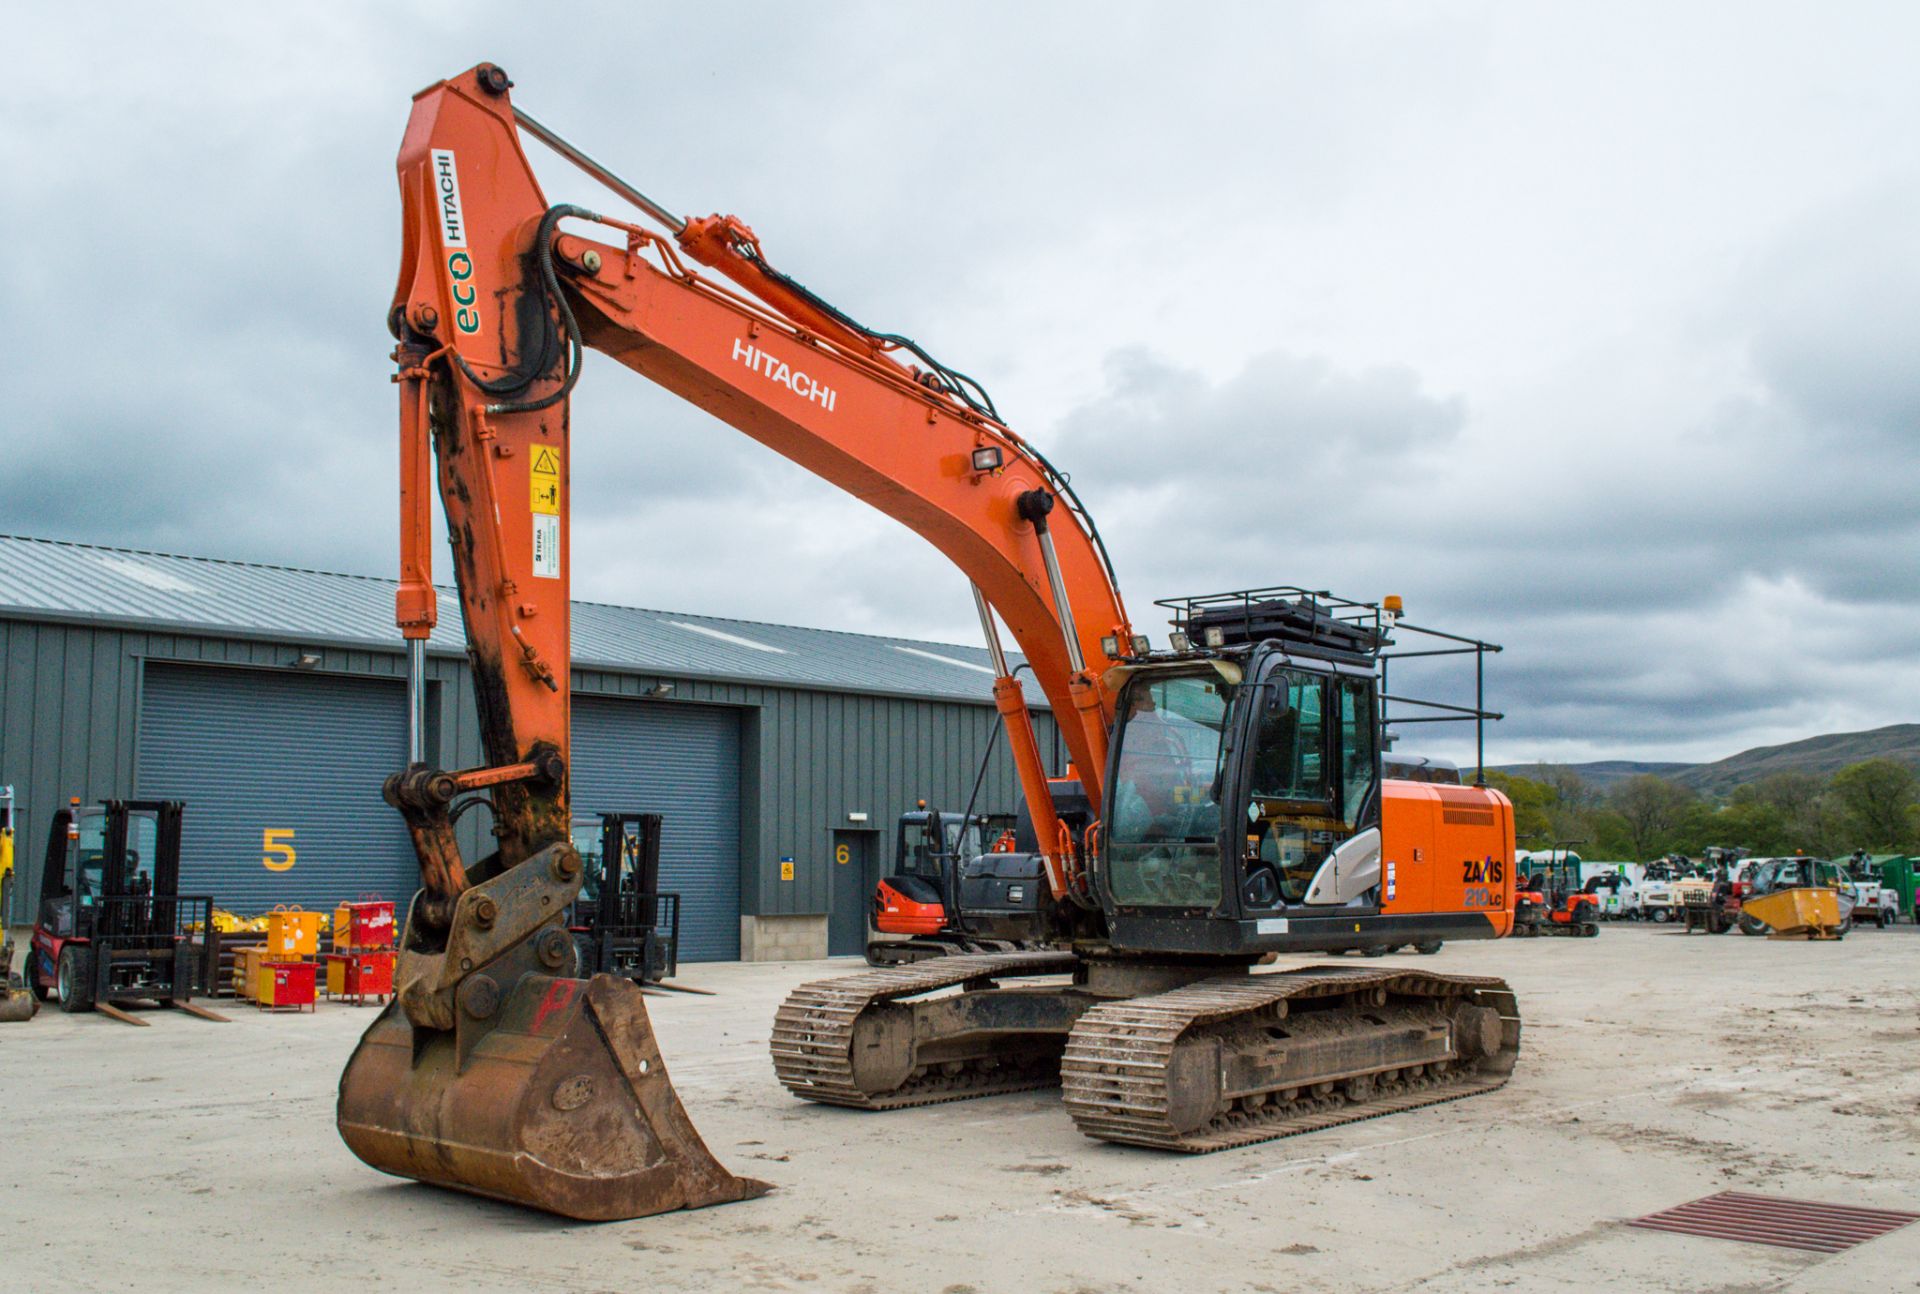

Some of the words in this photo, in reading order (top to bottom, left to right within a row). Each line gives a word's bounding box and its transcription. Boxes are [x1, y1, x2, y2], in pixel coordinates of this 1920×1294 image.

[437, 155, 461, 241] HITACHI
[731, 338, 837, 413] HITACHI
[263, 829, 296, 872] 5
[836, 844, 850, 865] 6
[1463, 856, 1503, 883] ZAXIS
